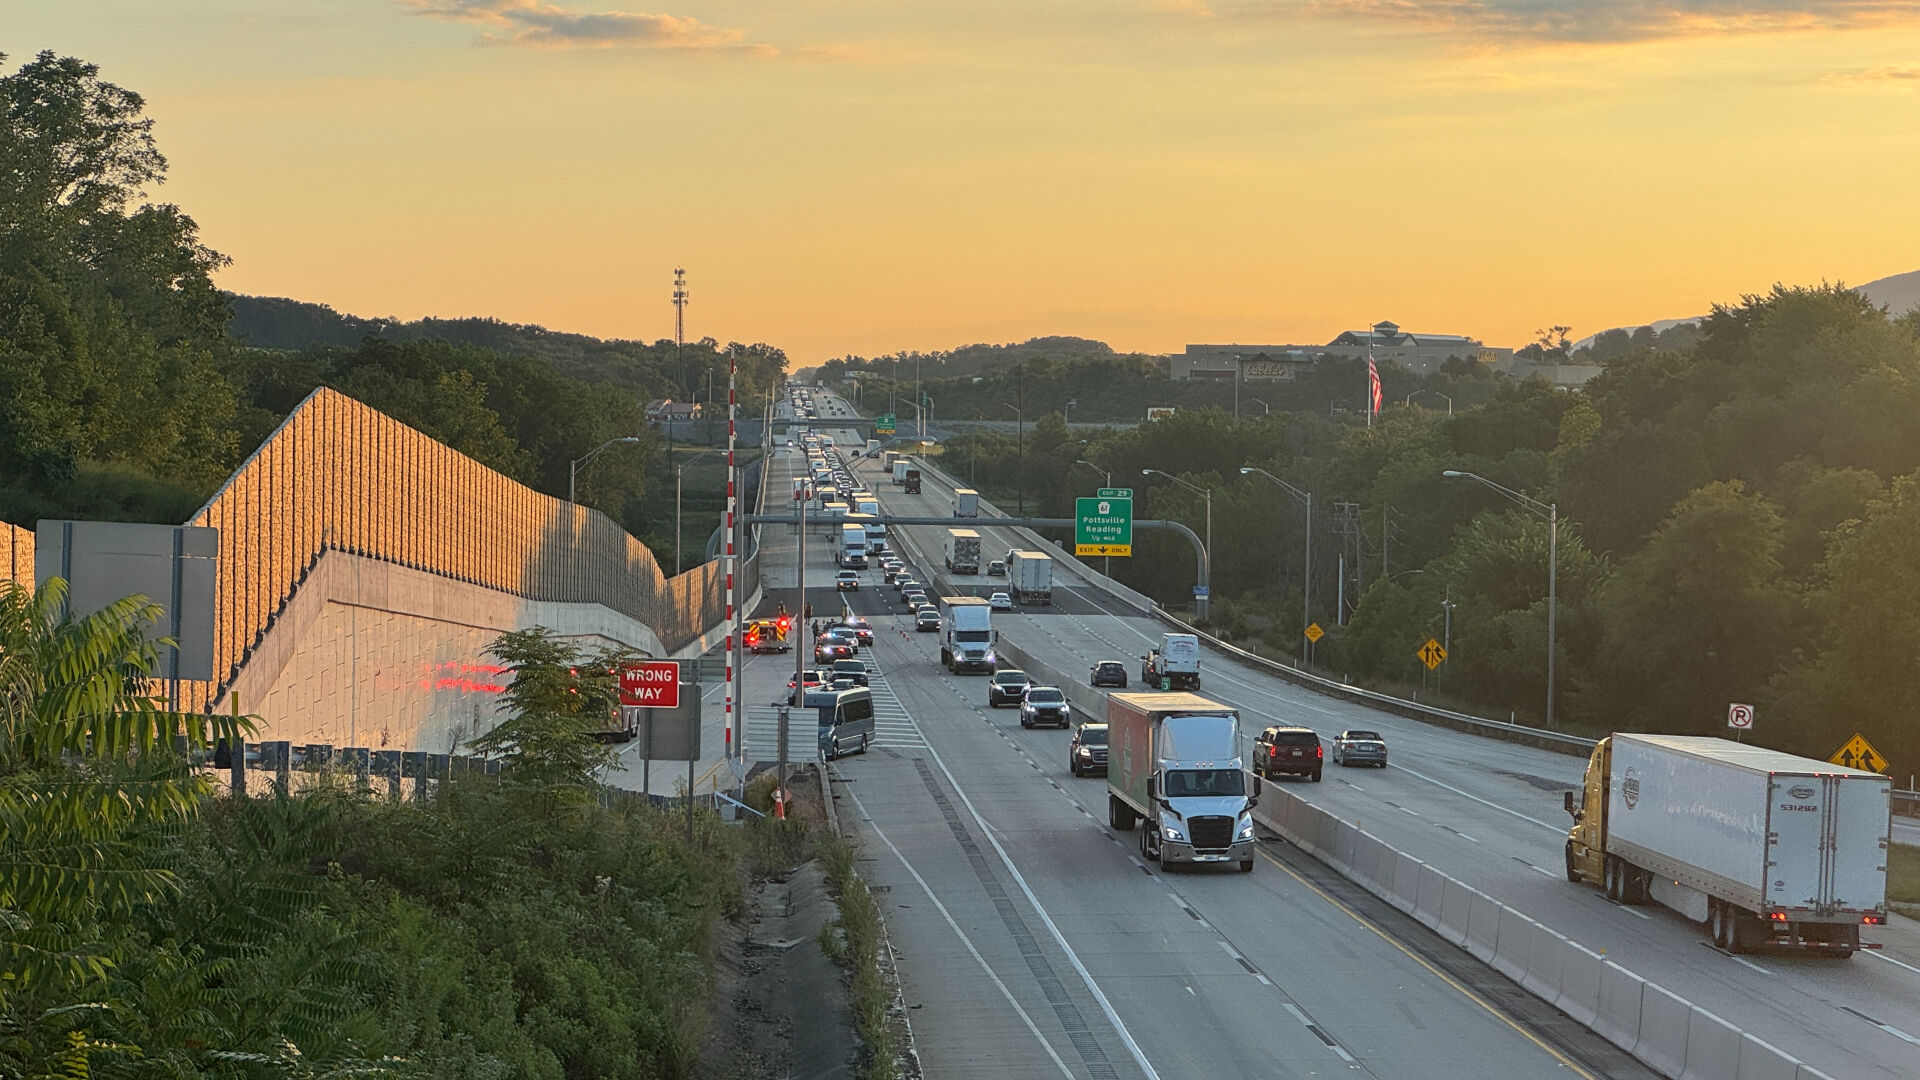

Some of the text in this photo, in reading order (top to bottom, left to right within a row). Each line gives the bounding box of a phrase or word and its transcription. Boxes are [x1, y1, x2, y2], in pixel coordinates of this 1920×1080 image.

[1083, 516, 1125, 524] Pottsville
[1085, 525, 1121, 534] Reading
[626, 669, 672, 682] WRONG
[634, 687, 663, 700] WAY
[1780, 804, 1818, 812] 531282
